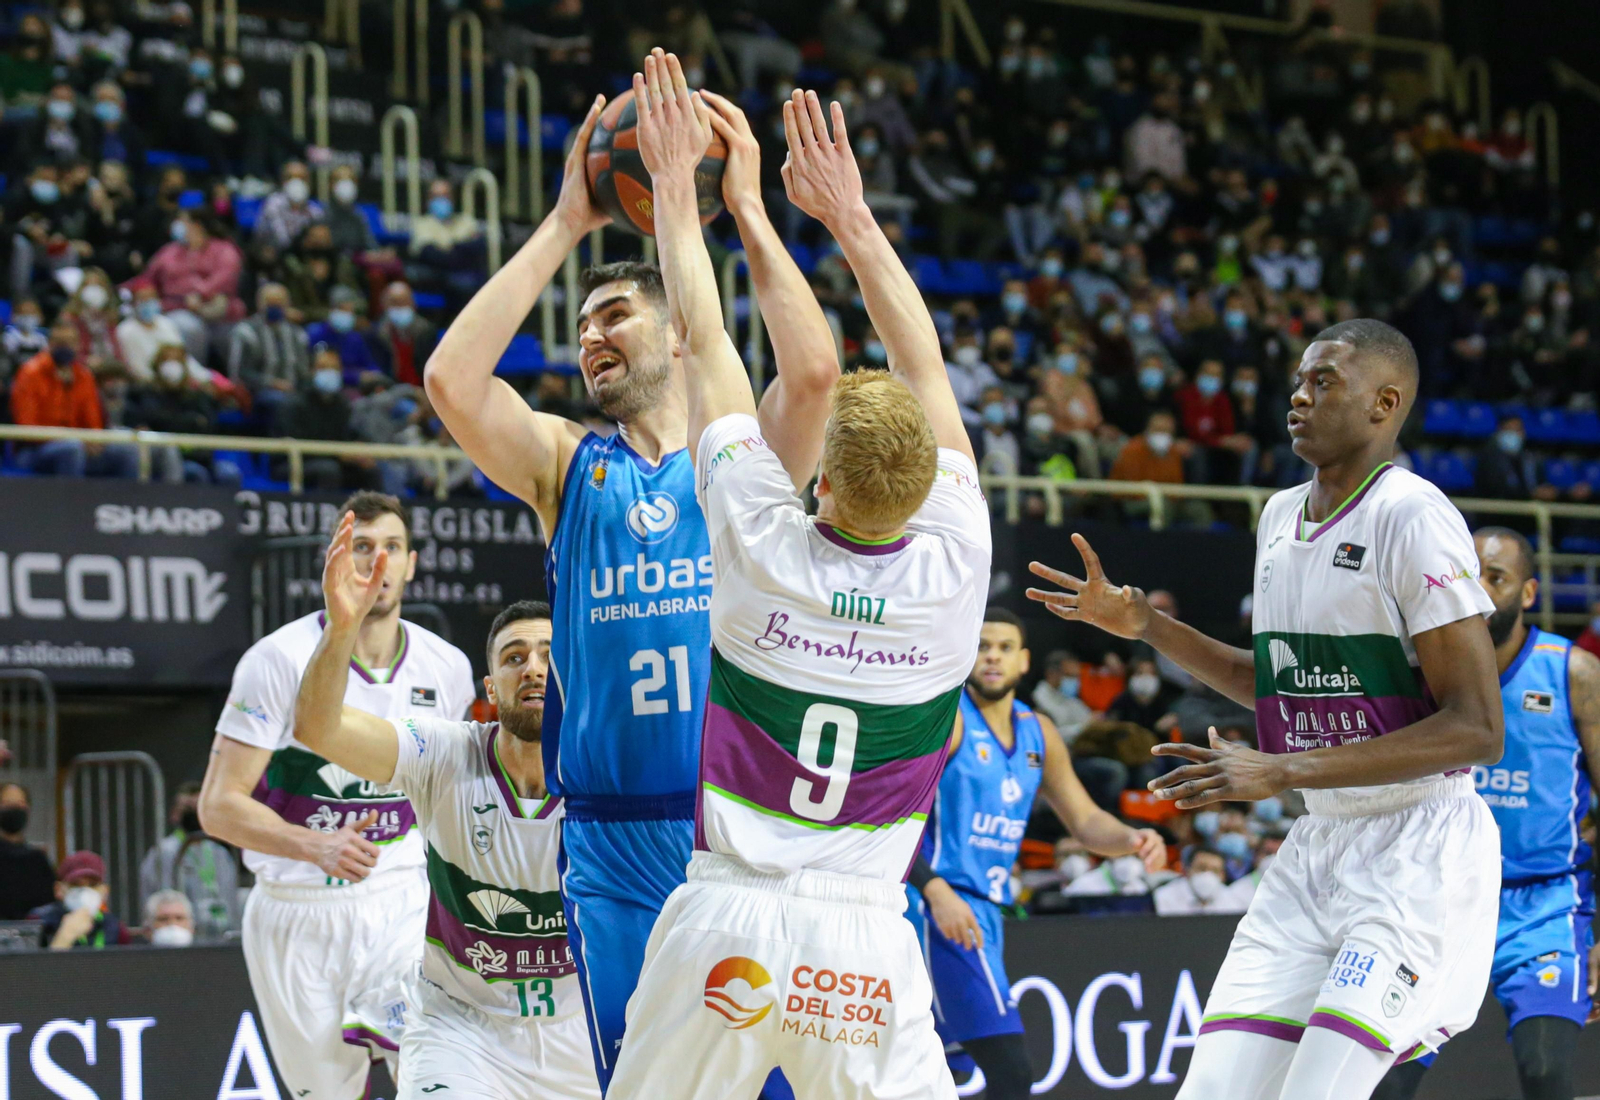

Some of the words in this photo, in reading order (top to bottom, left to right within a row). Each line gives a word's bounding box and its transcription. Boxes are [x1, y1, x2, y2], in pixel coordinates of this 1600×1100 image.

[95, 504, 224, 536] SHARP
[234, 490, 339, 535] GRUP
[590, 553, 713, 599] urbas
[590, 595, 711, 624] FUENLABRAD
[831, 588, 886, 625] DÍAZ
[754, 611, 930, 674] Benahavís
[629, 645, 692, 716] 21
[1294, 665, 1361, 692] Unicaja
[1296, 708, 1367, 733] MÁLAGA
[1295, 736, 1324, 751] Deport
[789, 703, 859, 821] 9
[986, 865, 1009, 904] 3
[516, 945, 574, 965] MÁLA
[516, 966, 549, 974] Deporte
[792, 965, 893, 1003] COSTA
[1397, 969, 1412, 984] acb
[513, 979, 556, 1017] 13
[785, 994, 835, 1019] DEL
[841, 1003, 887, 1027] SOL
[781, 1017, 879, 1048] MÁLAGA
[1006, 968, 1204, 1095] OGA
